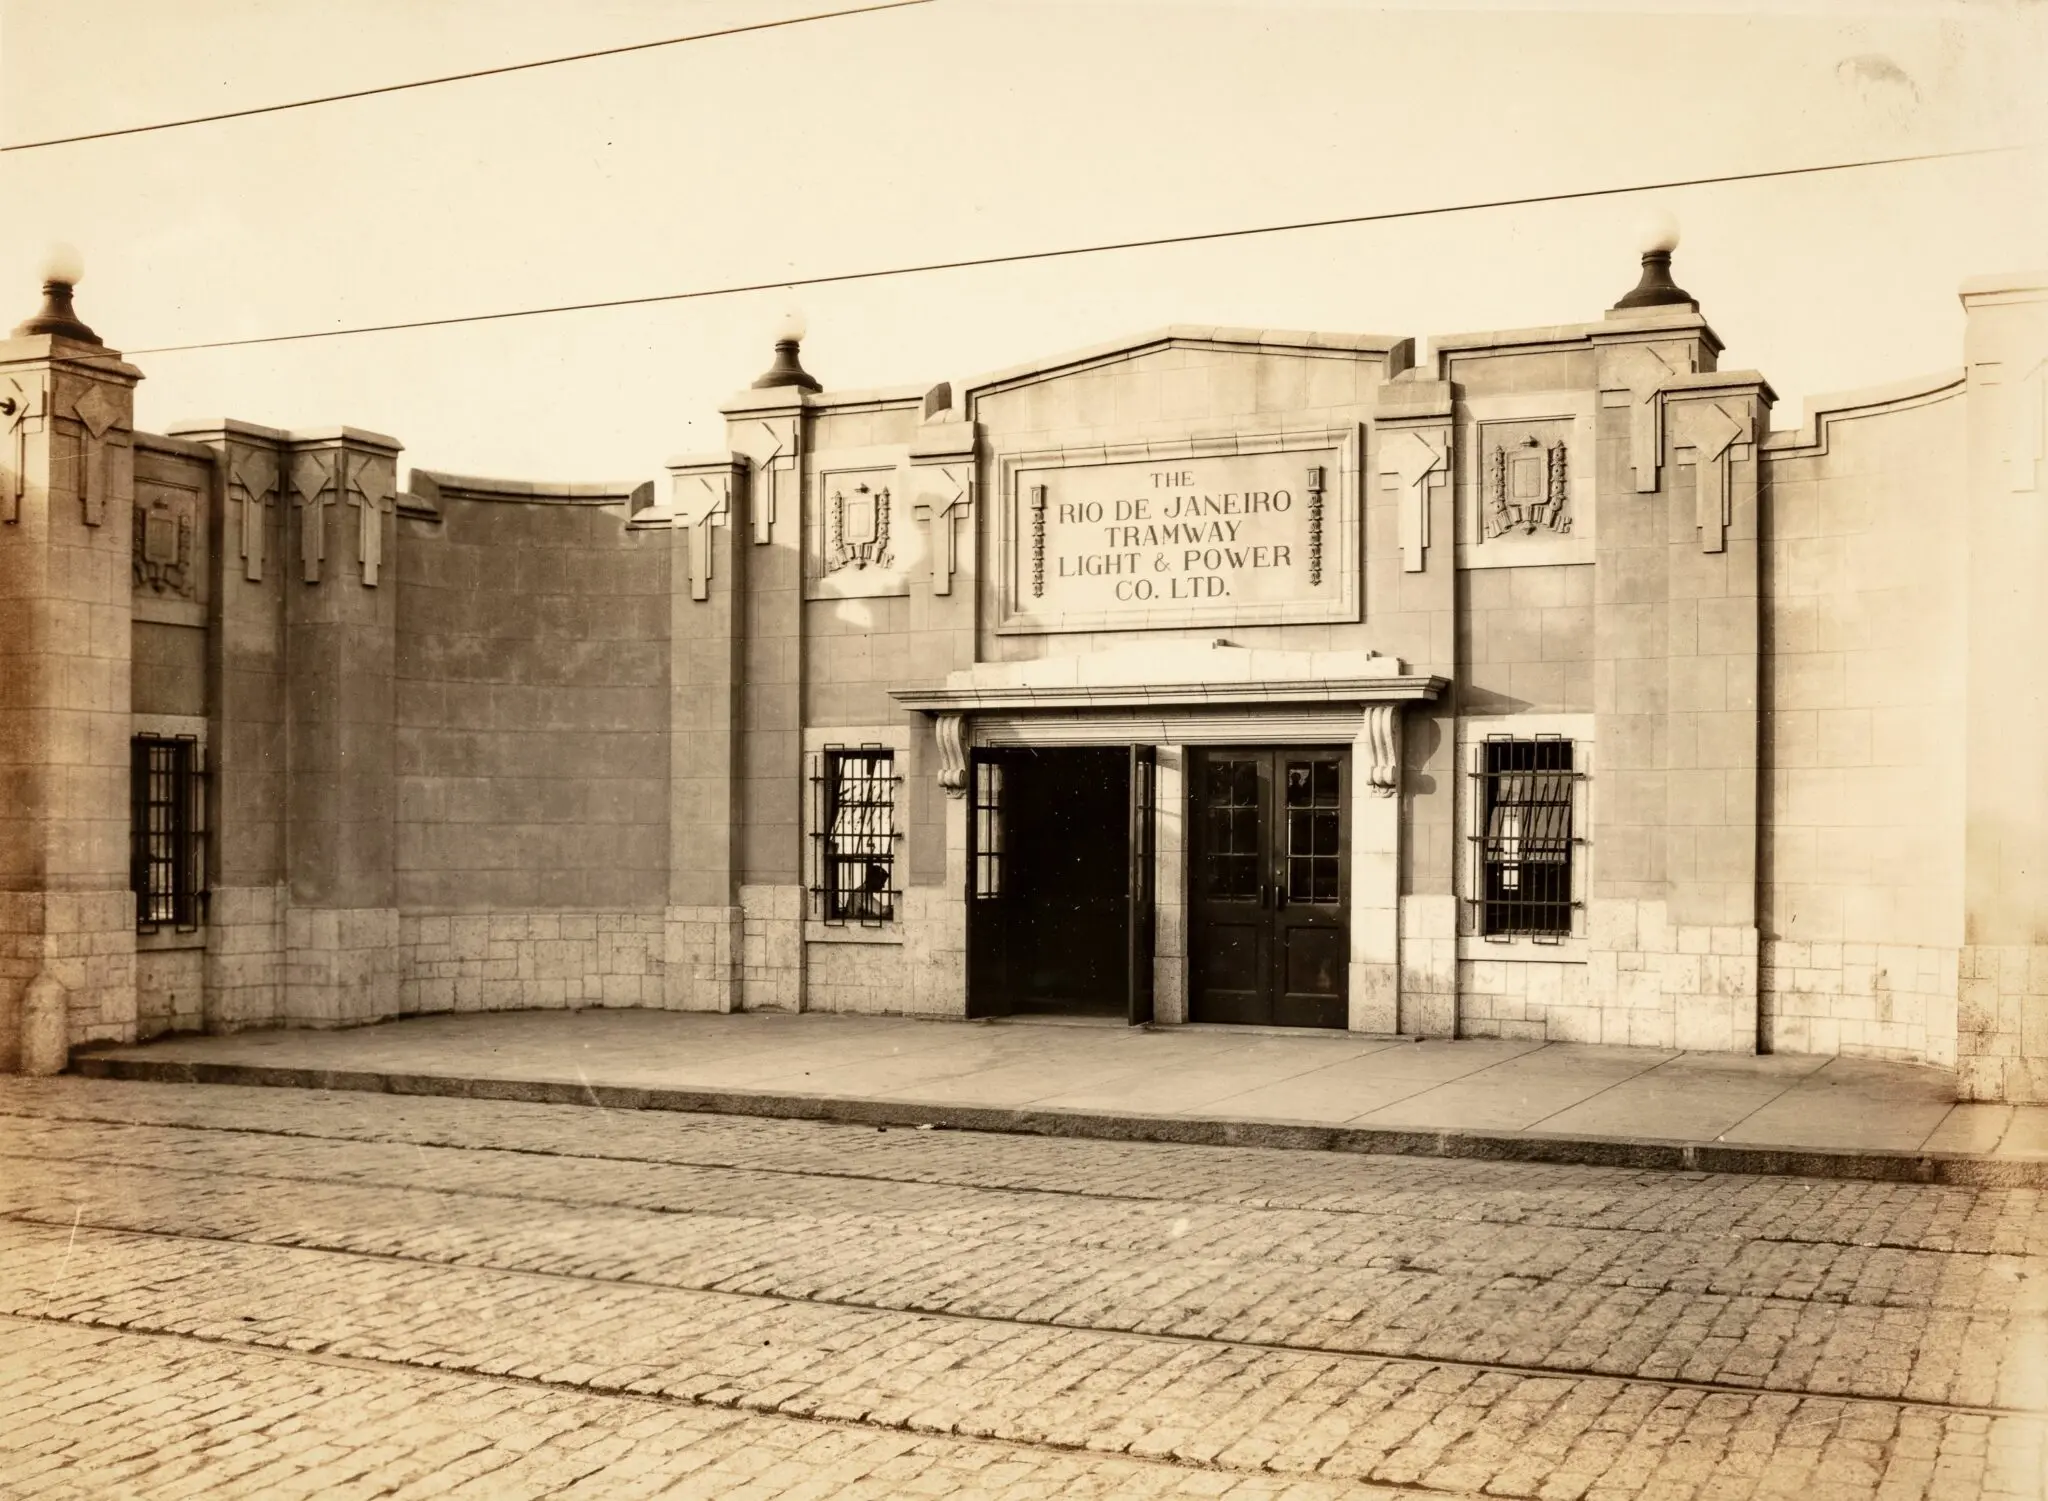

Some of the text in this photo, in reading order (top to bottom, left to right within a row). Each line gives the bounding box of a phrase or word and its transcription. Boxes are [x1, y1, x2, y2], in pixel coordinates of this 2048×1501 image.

[1151, 471, 1194, 488] THE
[1059, 490, 1291, 524] RIO DE JANEIRO
[1104, 520, 1242, 548] TRAMWAY
[1059, 545, 1291, 577] LIGHT & POWER
[1115, 576, 1230, 601] CO. LTD.
